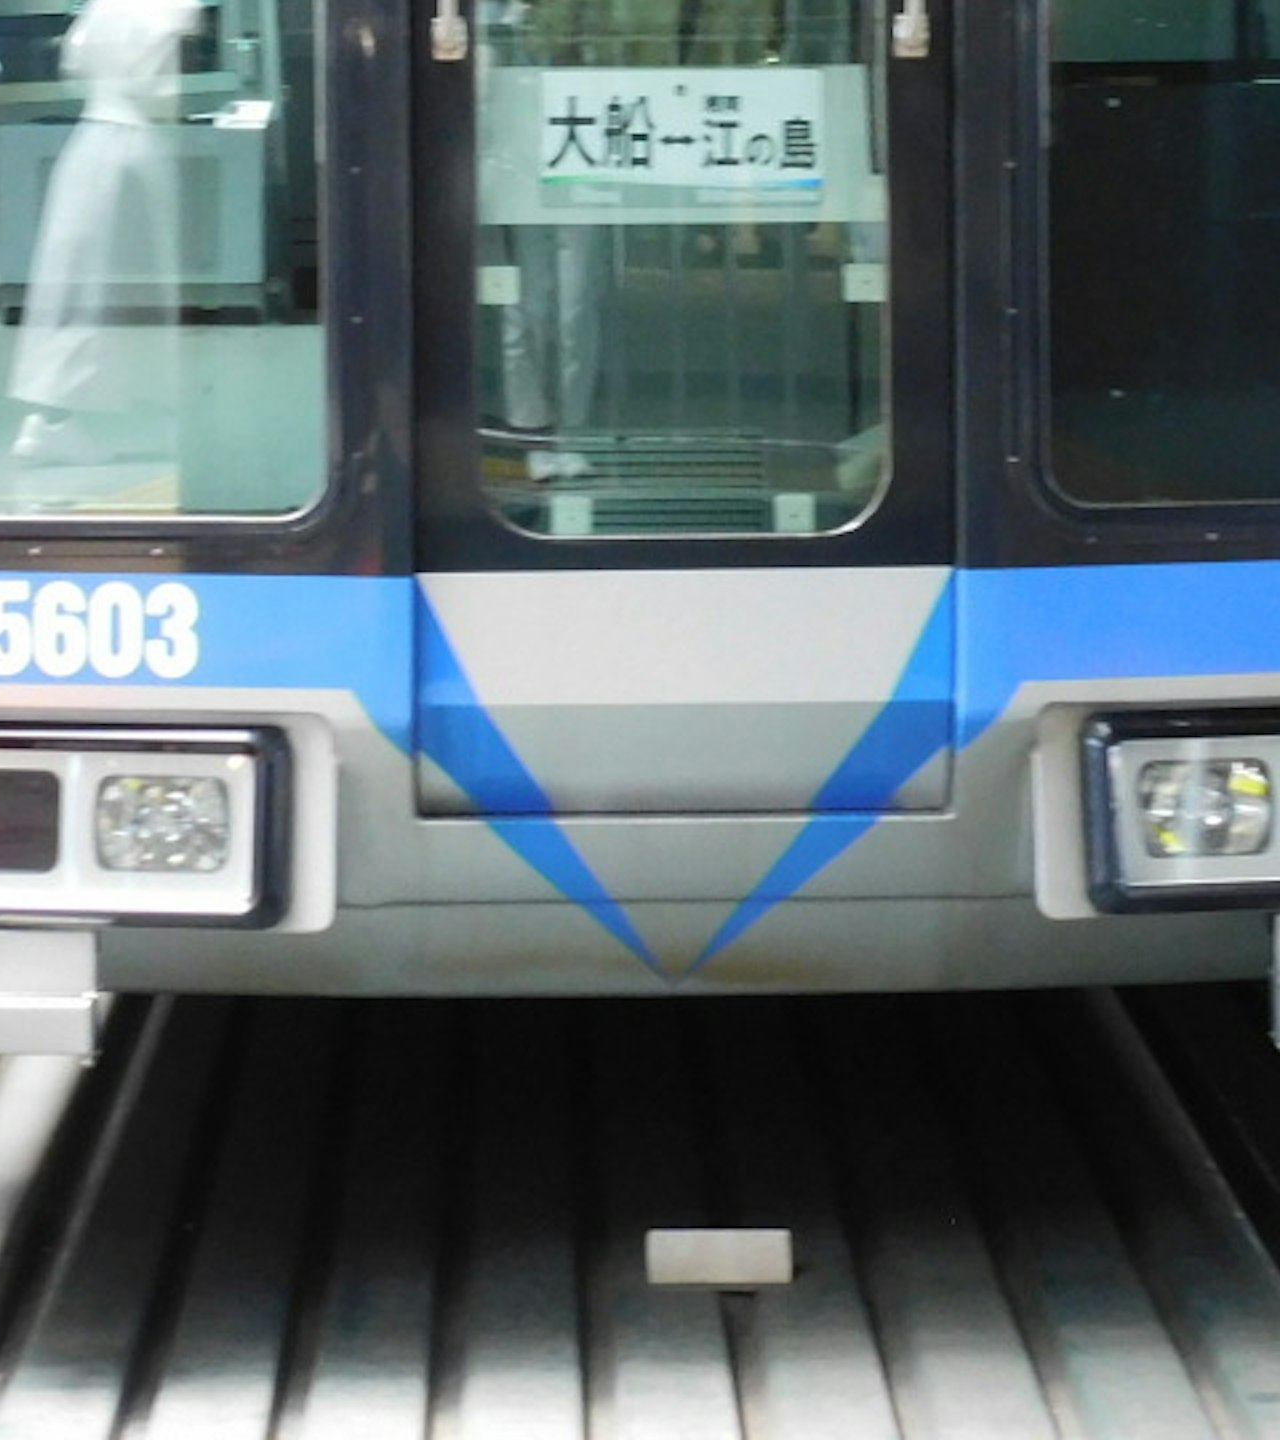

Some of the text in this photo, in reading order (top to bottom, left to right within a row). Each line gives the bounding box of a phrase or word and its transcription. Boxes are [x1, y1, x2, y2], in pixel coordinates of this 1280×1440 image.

[548, 96, 816, 168] 大船 江の島
